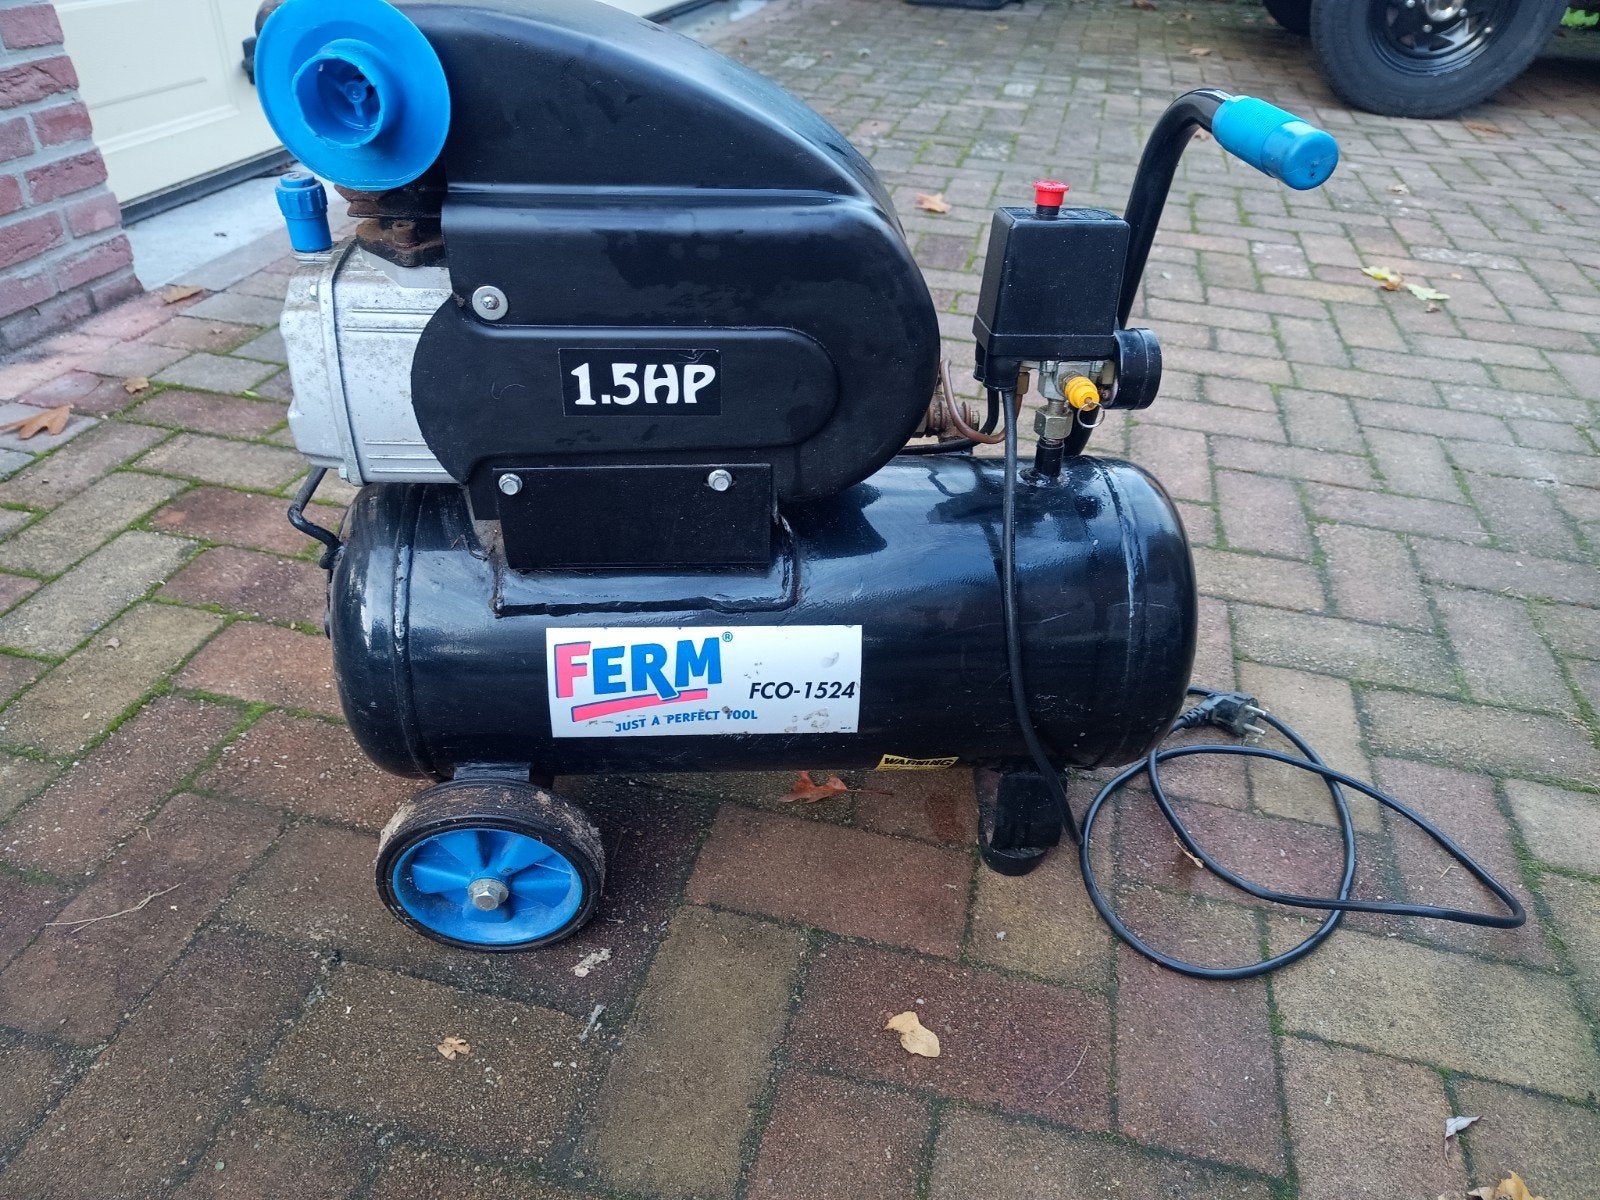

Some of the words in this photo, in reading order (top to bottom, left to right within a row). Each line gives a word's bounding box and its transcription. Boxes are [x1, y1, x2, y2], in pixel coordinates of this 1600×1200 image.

[571, 362, 716, 406] 1.5HP
[749, 681, 856, 700] FCO-1524
[615, 718, 647, 732] JUST
[651, 715, 661, 726] A
[666, 710, 720, 724] PERFECT
